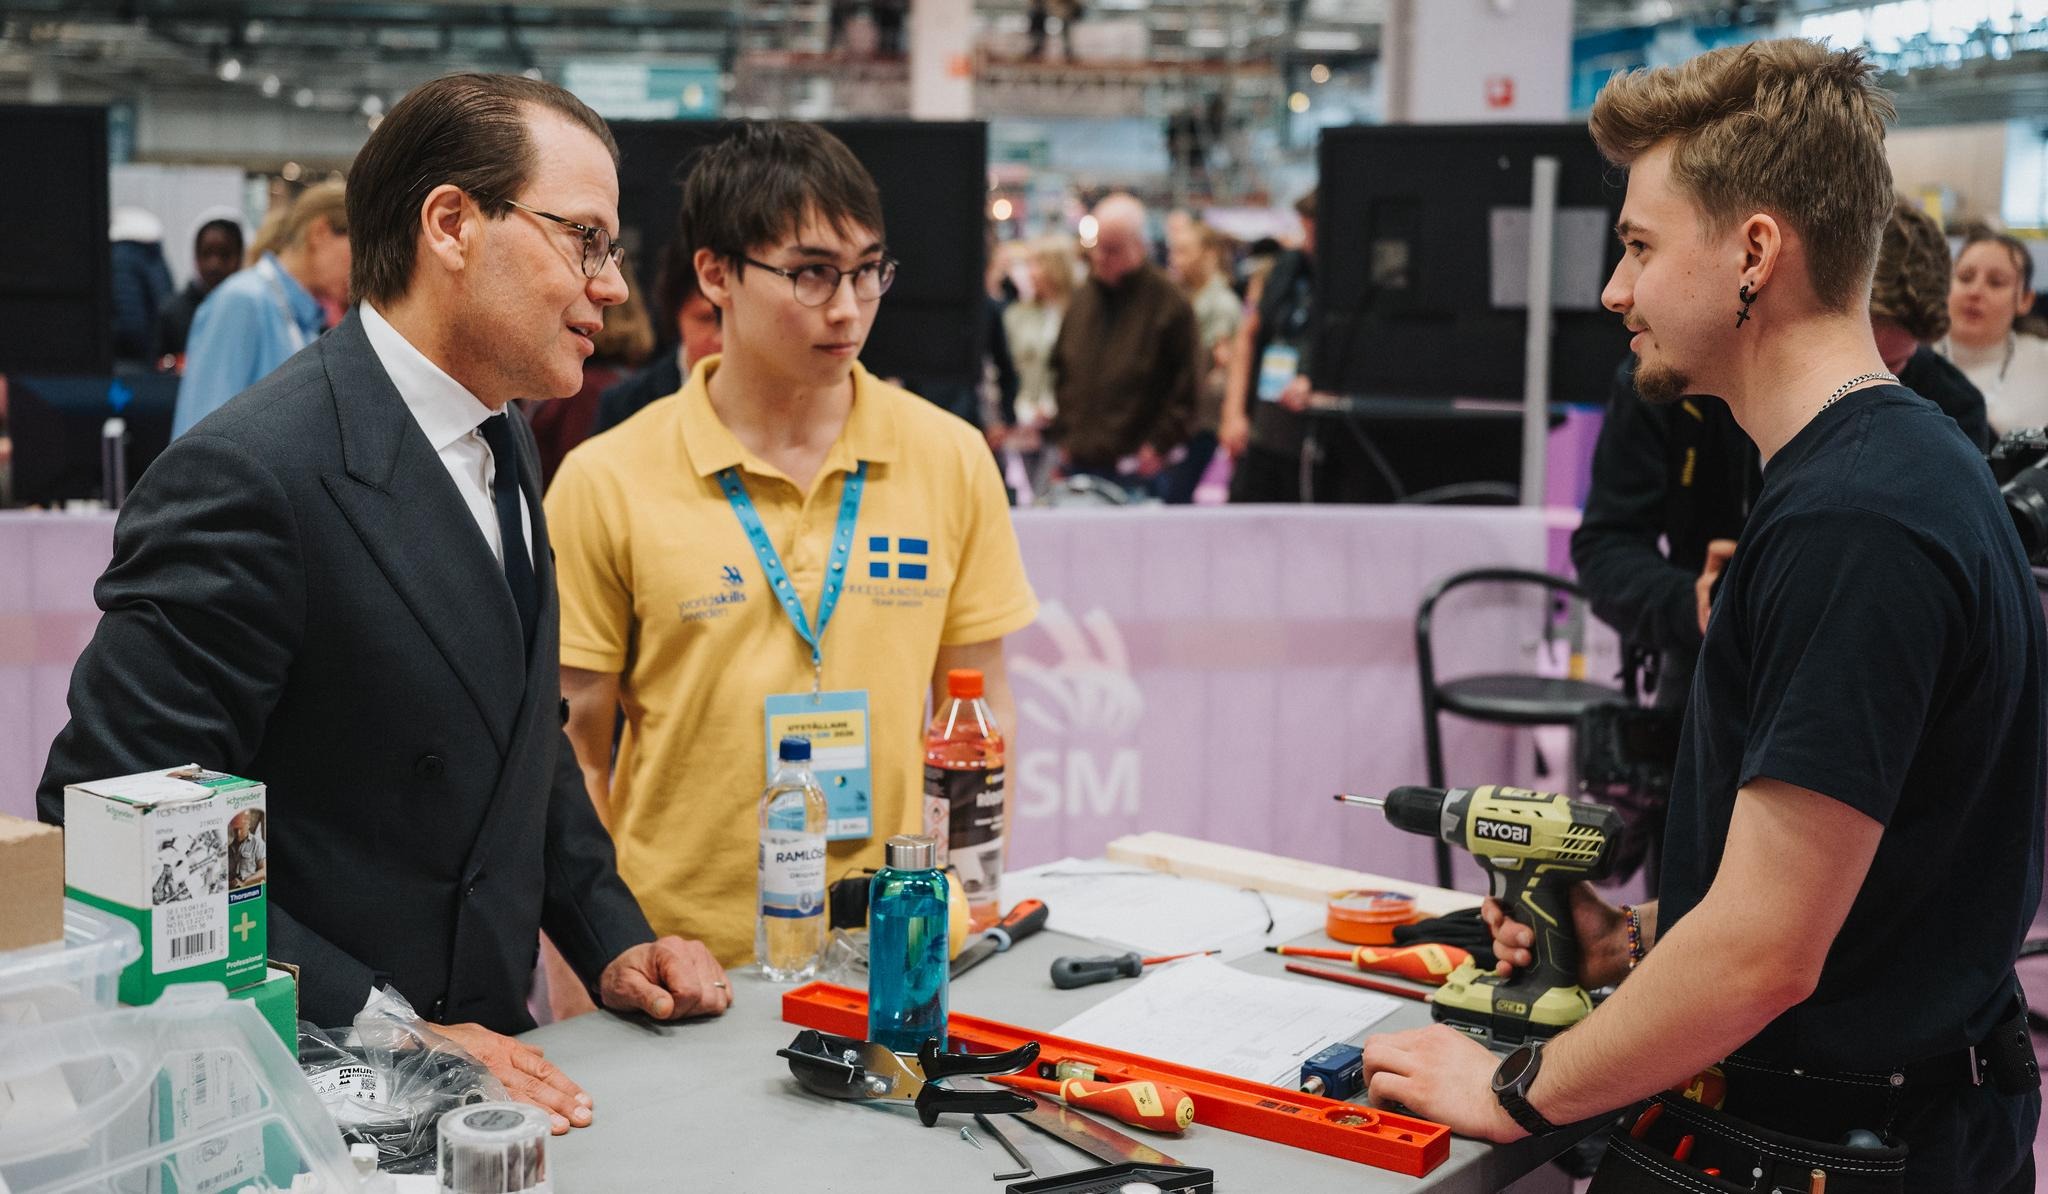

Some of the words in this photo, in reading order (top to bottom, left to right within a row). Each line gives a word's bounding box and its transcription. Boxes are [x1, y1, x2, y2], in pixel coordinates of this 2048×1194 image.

[1018, 749, 1140, 818] SM
[1477, 820, 1529, 843] RYOBI
[230, 889, 261, 903] Thorsman
